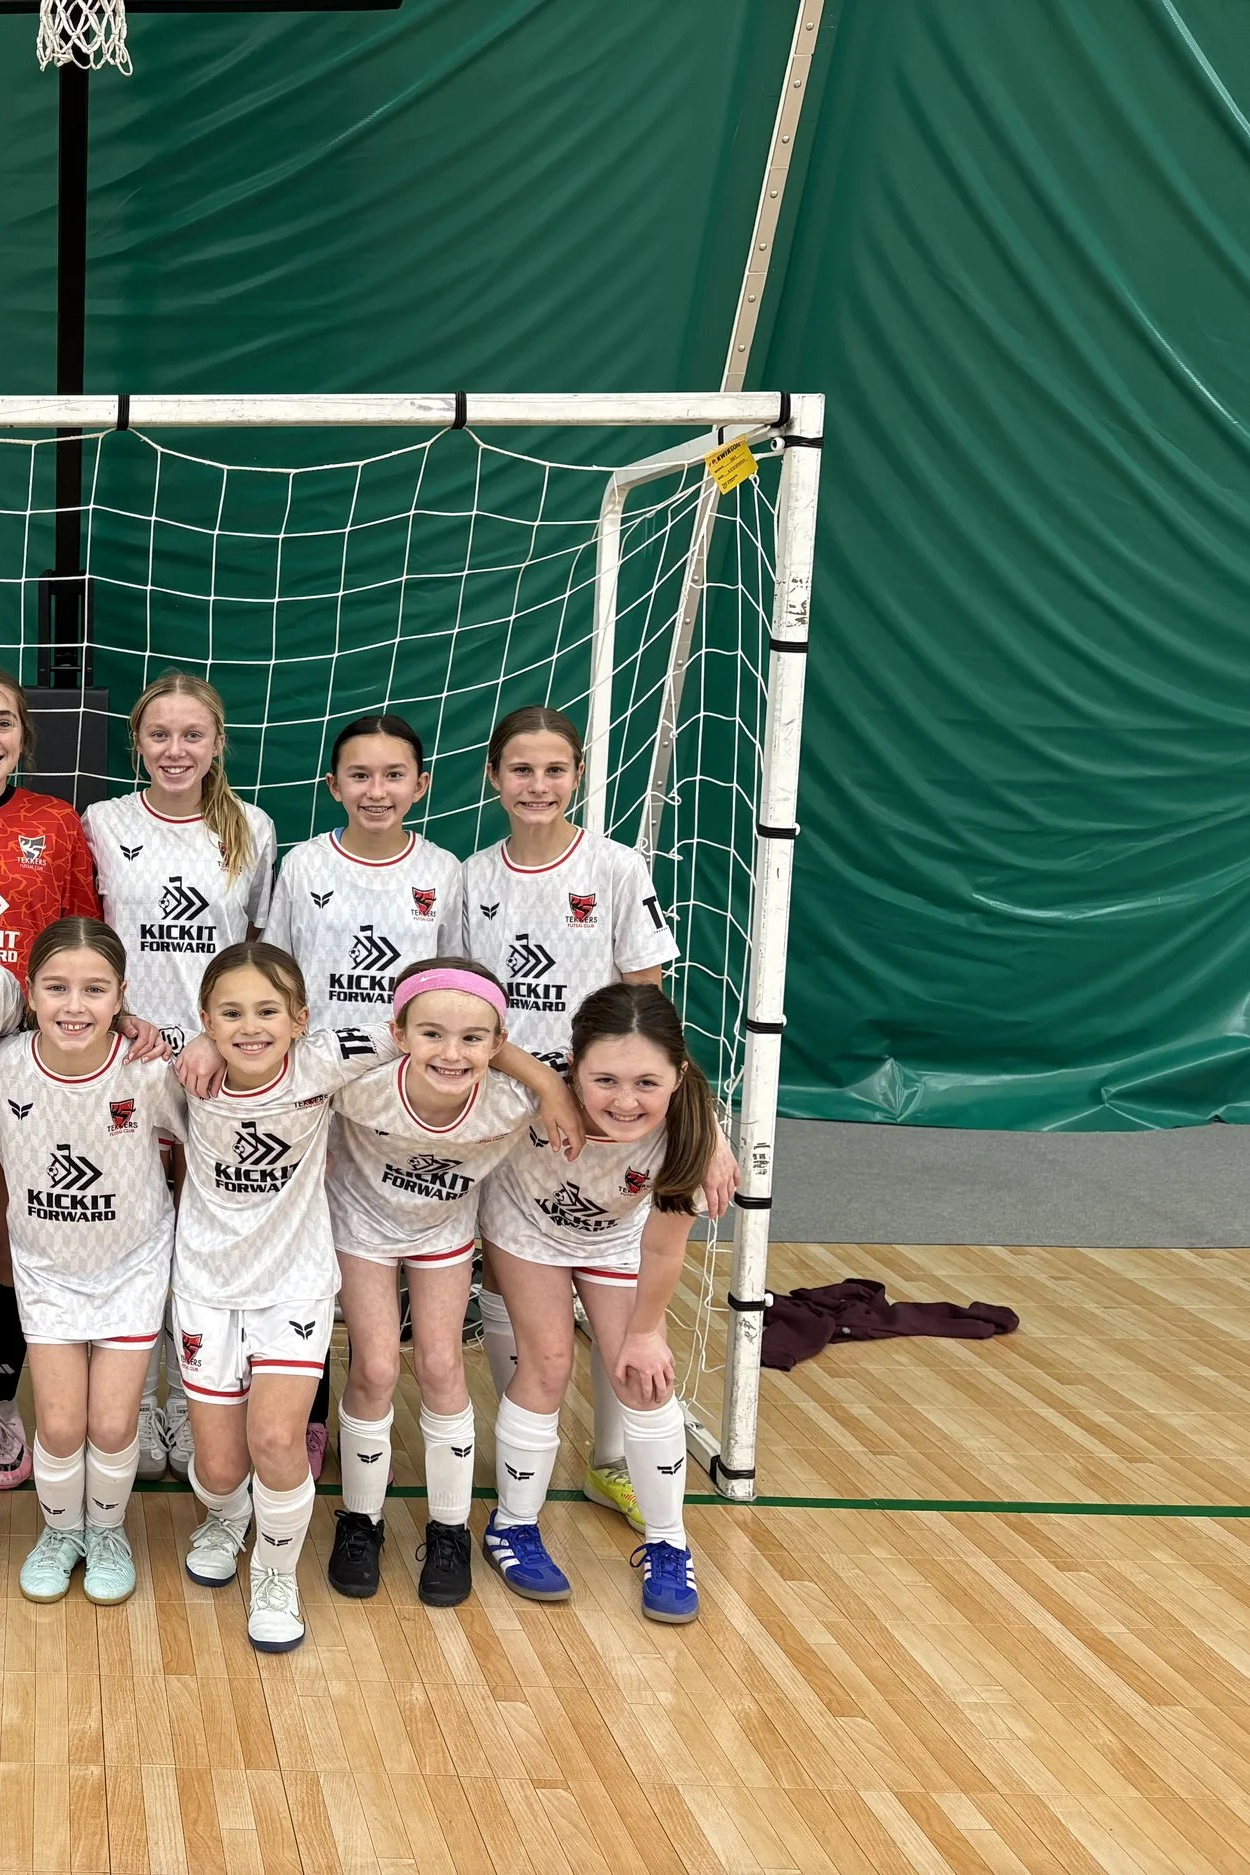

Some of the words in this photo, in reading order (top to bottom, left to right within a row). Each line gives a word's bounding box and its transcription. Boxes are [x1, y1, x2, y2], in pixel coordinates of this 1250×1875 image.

[140, 924, 217, 942] KICKIT
[140, 941, 217, 954] FORWARD
[329, 973, 396, 992] KICKI
[504, 982, 568, 1000] ICKIT
[328, 990, 395, 1004] FORWAR
[508, 998, 566, 1012] RWARD
[214, 1178, 288, 1193] FORWA
[27, 1188, 117, 1211] KICKIT
[27, 1205, 117, 1223] FORWARD
